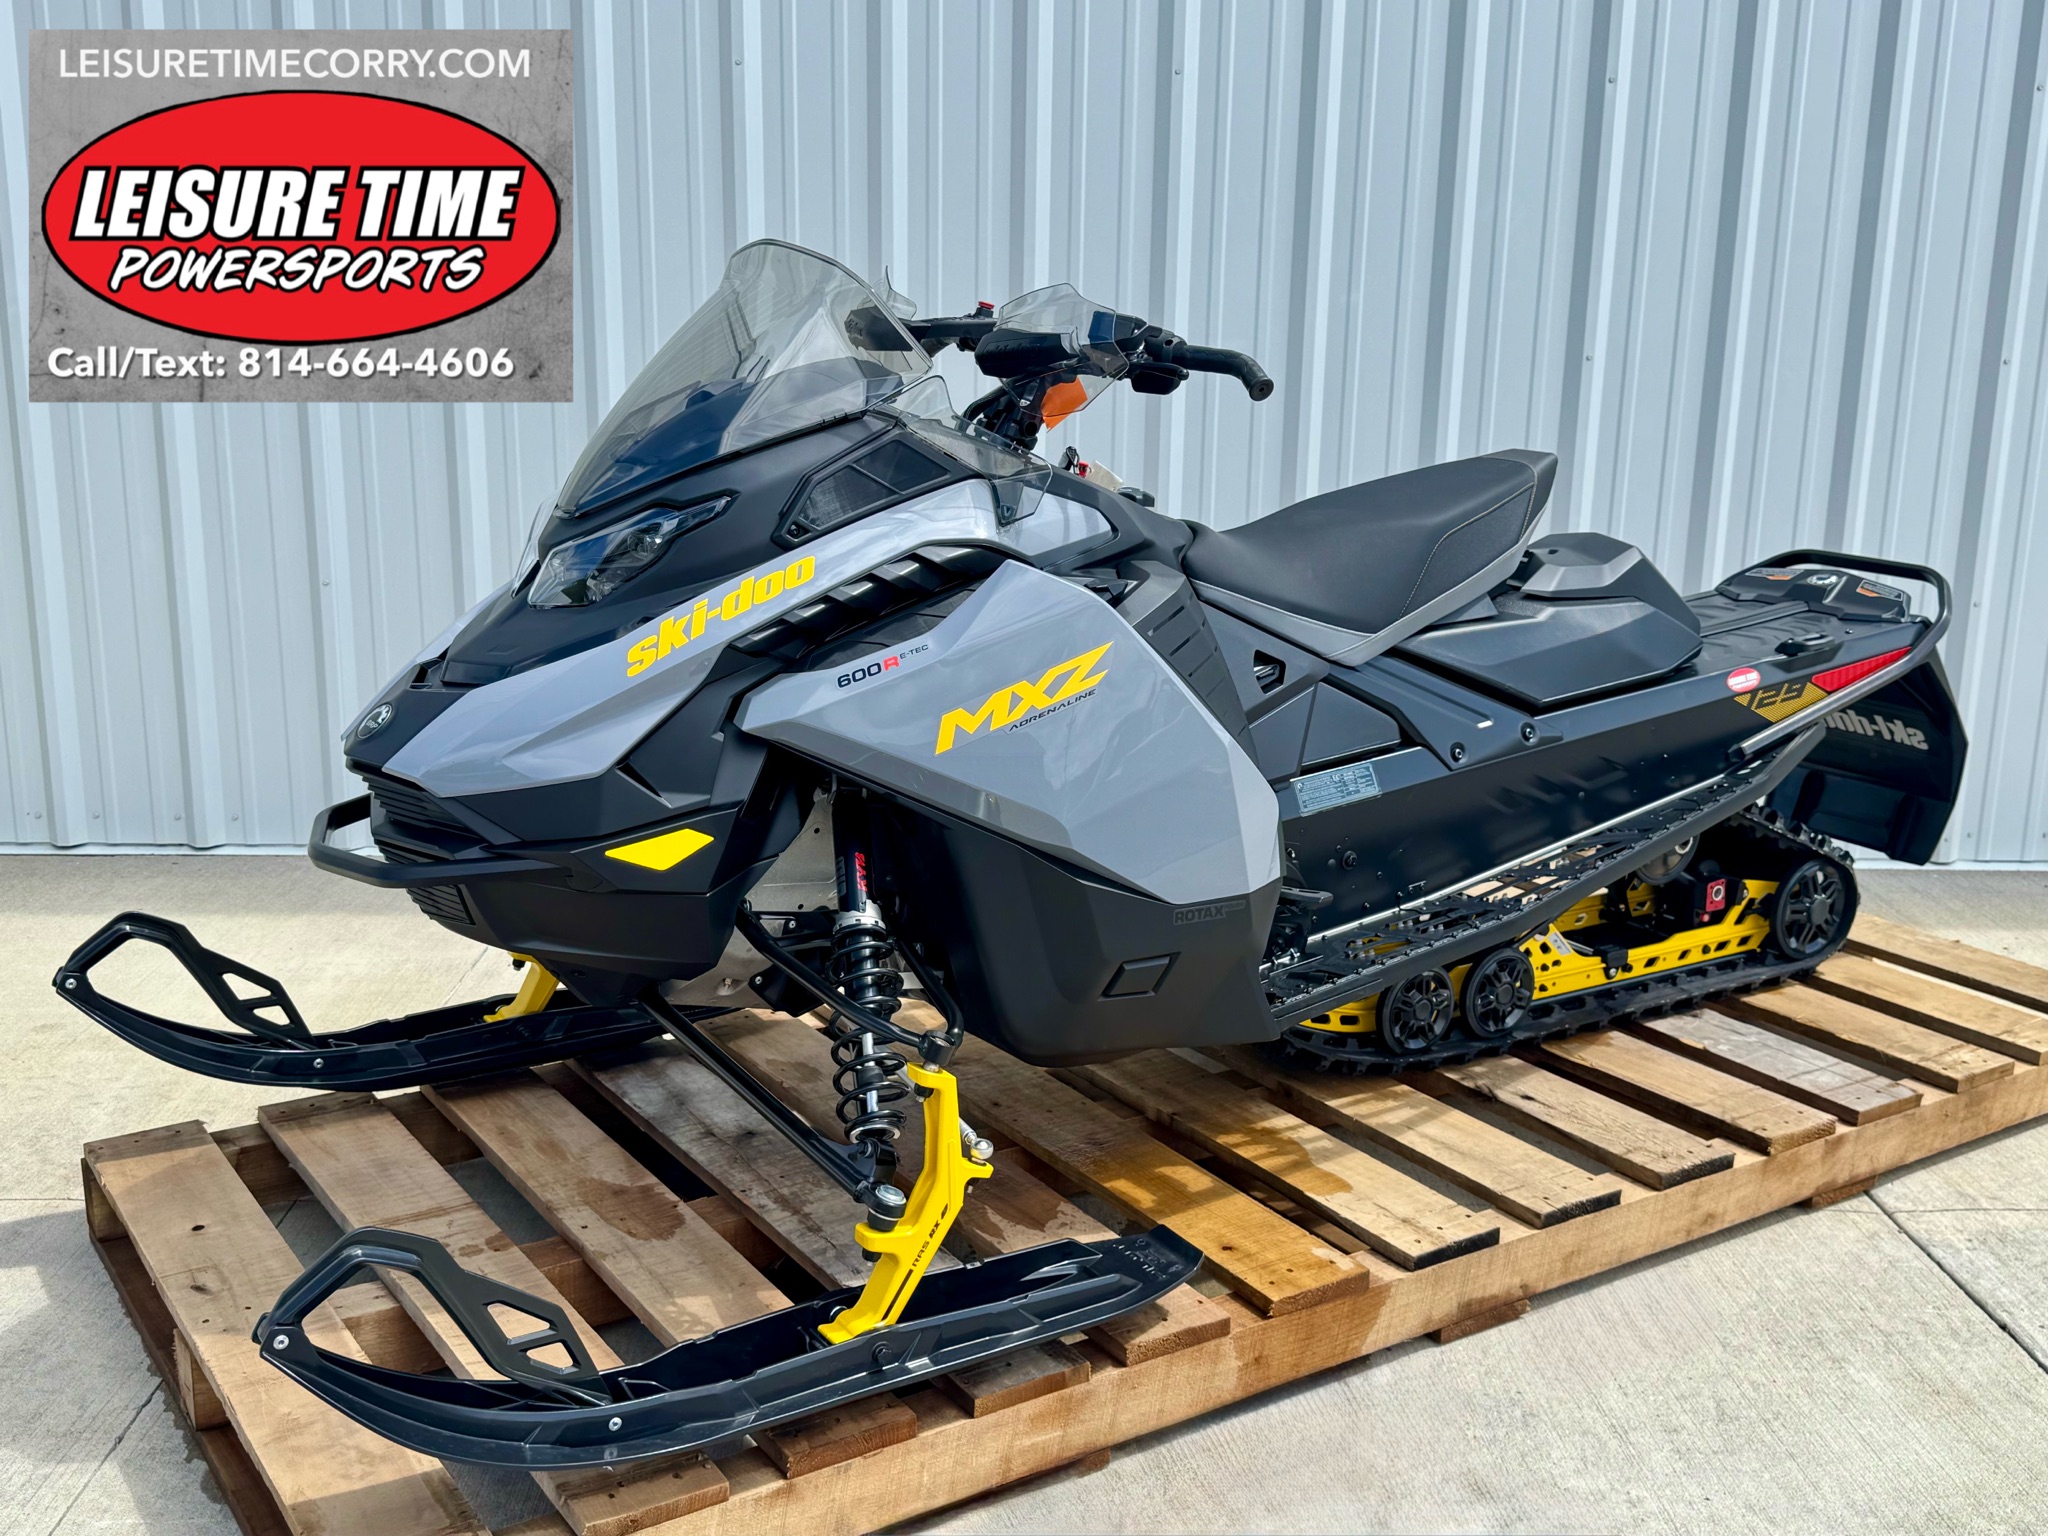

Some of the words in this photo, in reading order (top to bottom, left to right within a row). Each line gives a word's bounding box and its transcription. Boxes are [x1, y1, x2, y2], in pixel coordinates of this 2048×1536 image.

[626, 555, 816, 678] ski-doo
[900, 644, 929, 660] E-TEC
[935, 641, 1114, 755] MXZ
[1008, 688, 1097, 732] ADRENALINE
[1174, 904, 1225, 924] ROTAX
[912, 1240, 930, 1266] RAS
